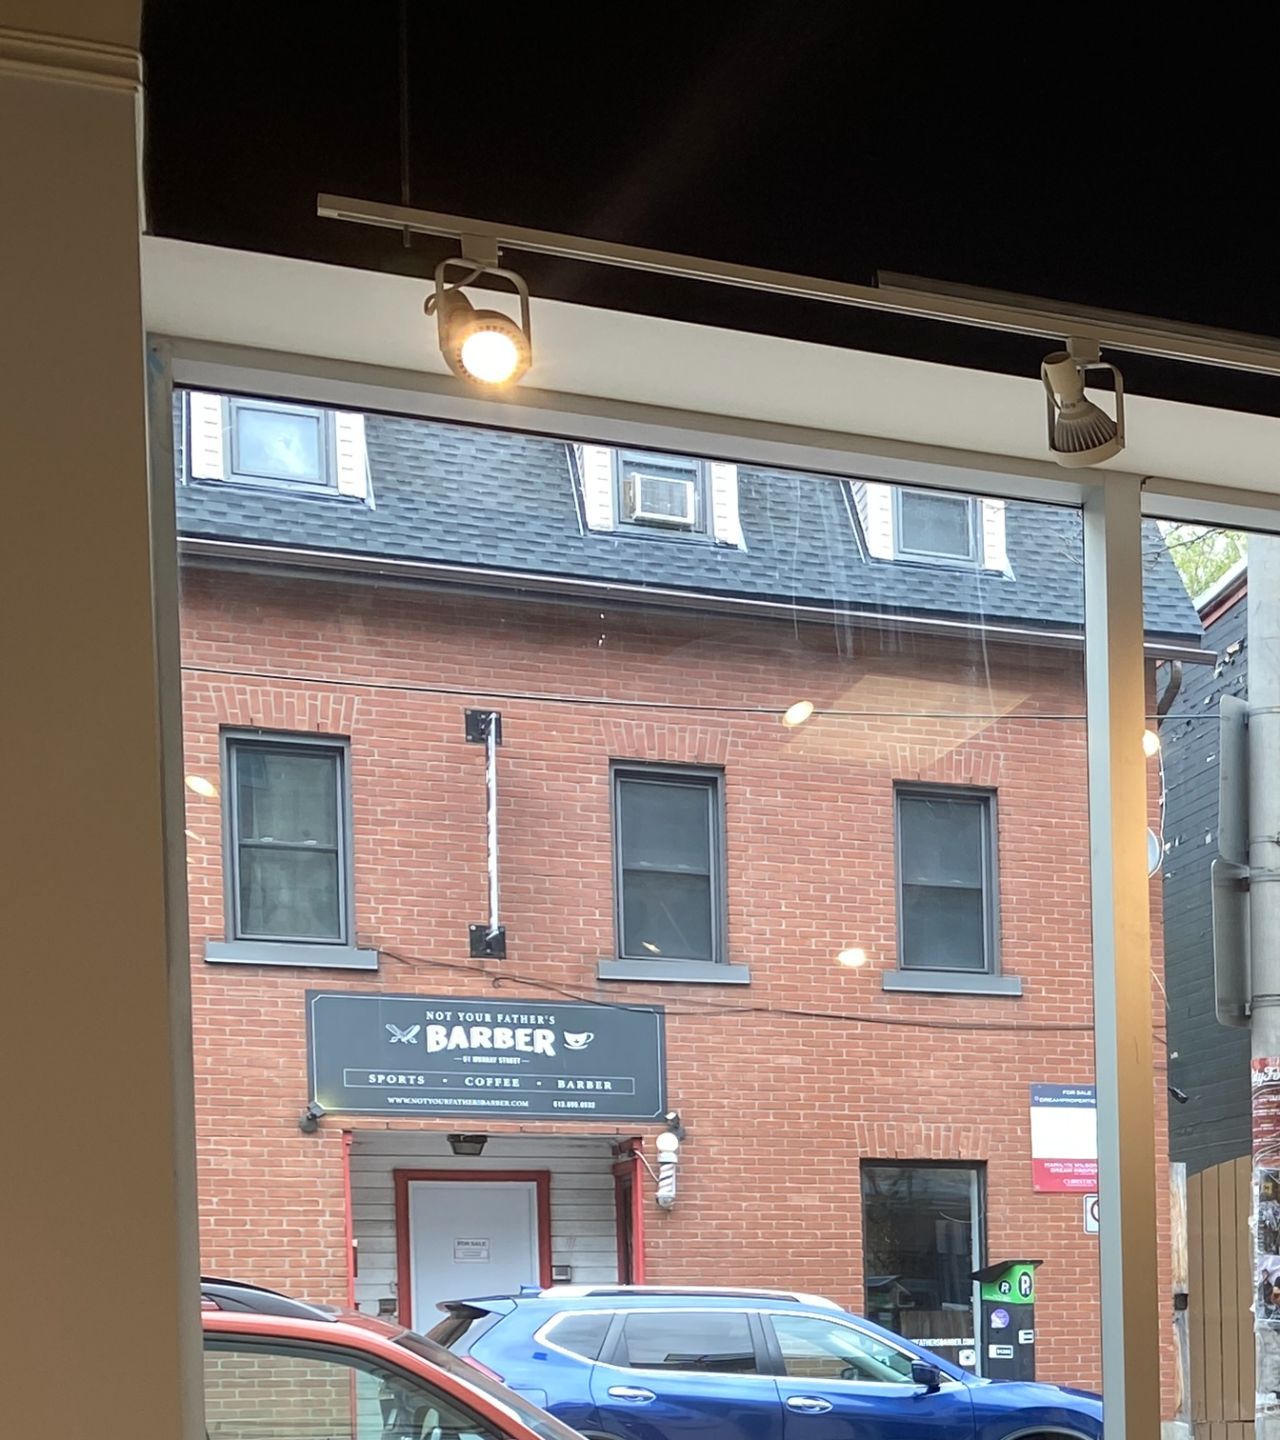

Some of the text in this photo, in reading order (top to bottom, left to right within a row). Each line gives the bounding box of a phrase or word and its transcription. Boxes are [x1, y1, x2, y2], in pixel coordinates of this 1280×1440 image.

[426, 1011, 556, 1025] NOT YOUR FATHER'S
[426, 1024, 557, 1056] BARBER
[368, 1074, 612, 1090] SPORTS COFFEE BARBER
